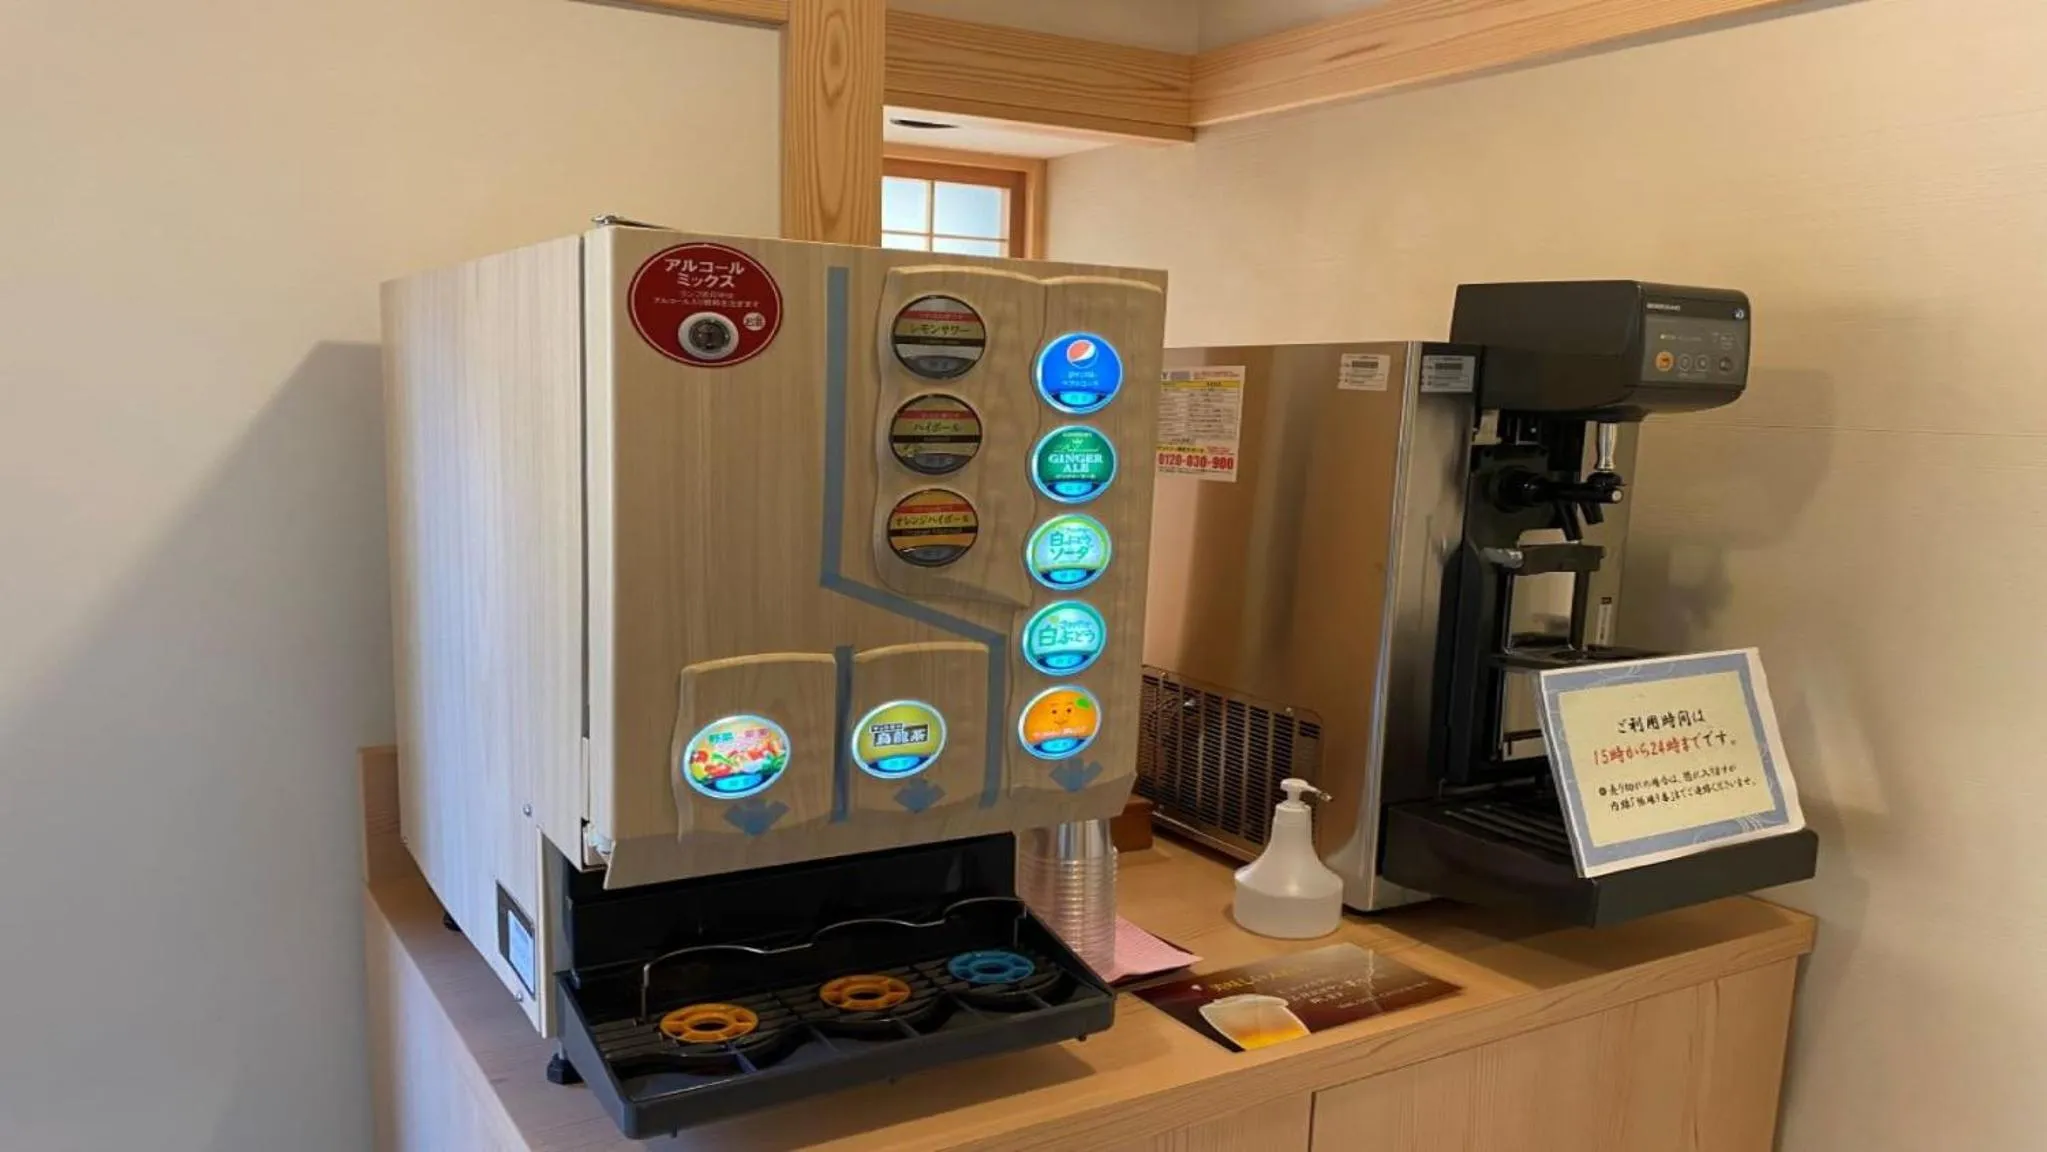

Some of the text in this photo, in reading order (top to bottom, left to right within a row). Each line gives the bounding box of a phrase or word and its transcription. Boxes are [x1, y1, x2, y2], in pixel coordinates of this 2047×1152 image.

[664, 259, 745, 275] アルコール
[676, 273, 736, 288] ミックス
[911, 323, 972, 336] レモンサワー
[912, 421, 961, 433] ハイボール
[1047, 453, 1104, 464] GINGER
[1062, 463, 1089, 473] ALE
[1049, 545, 1090, 561] ソーダ
[1038, 624, 1096, 647] 白ぶどう
[1617, 708, 1707, 734] ご利用時間は
[1593, 730, 1737, 766] 15時から24時までです。
